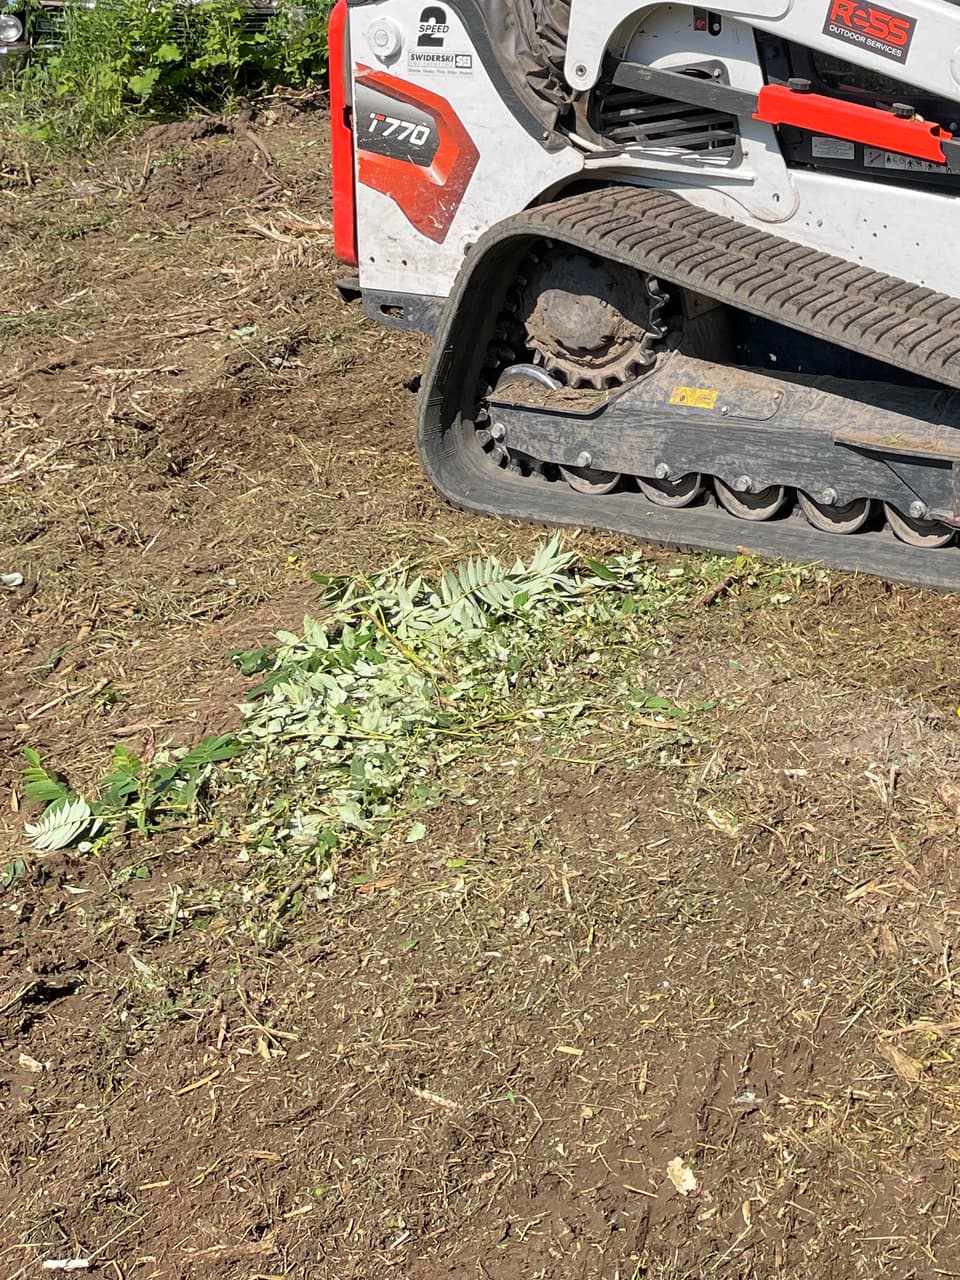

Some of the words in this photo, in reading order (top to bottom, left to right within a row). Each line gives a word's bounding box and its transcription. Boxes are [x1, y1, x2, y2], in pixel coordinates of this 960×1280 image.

[417, 6, 447, 47] 2
[418, 24, 450, 33] SPEED
[829, 24, 866, 43] OUTDOOR
[866, 38, 903, 57] SERVICES
[410, 53, 454, 62] SWIDERSKI
[368, 112, 430, 146] T770
